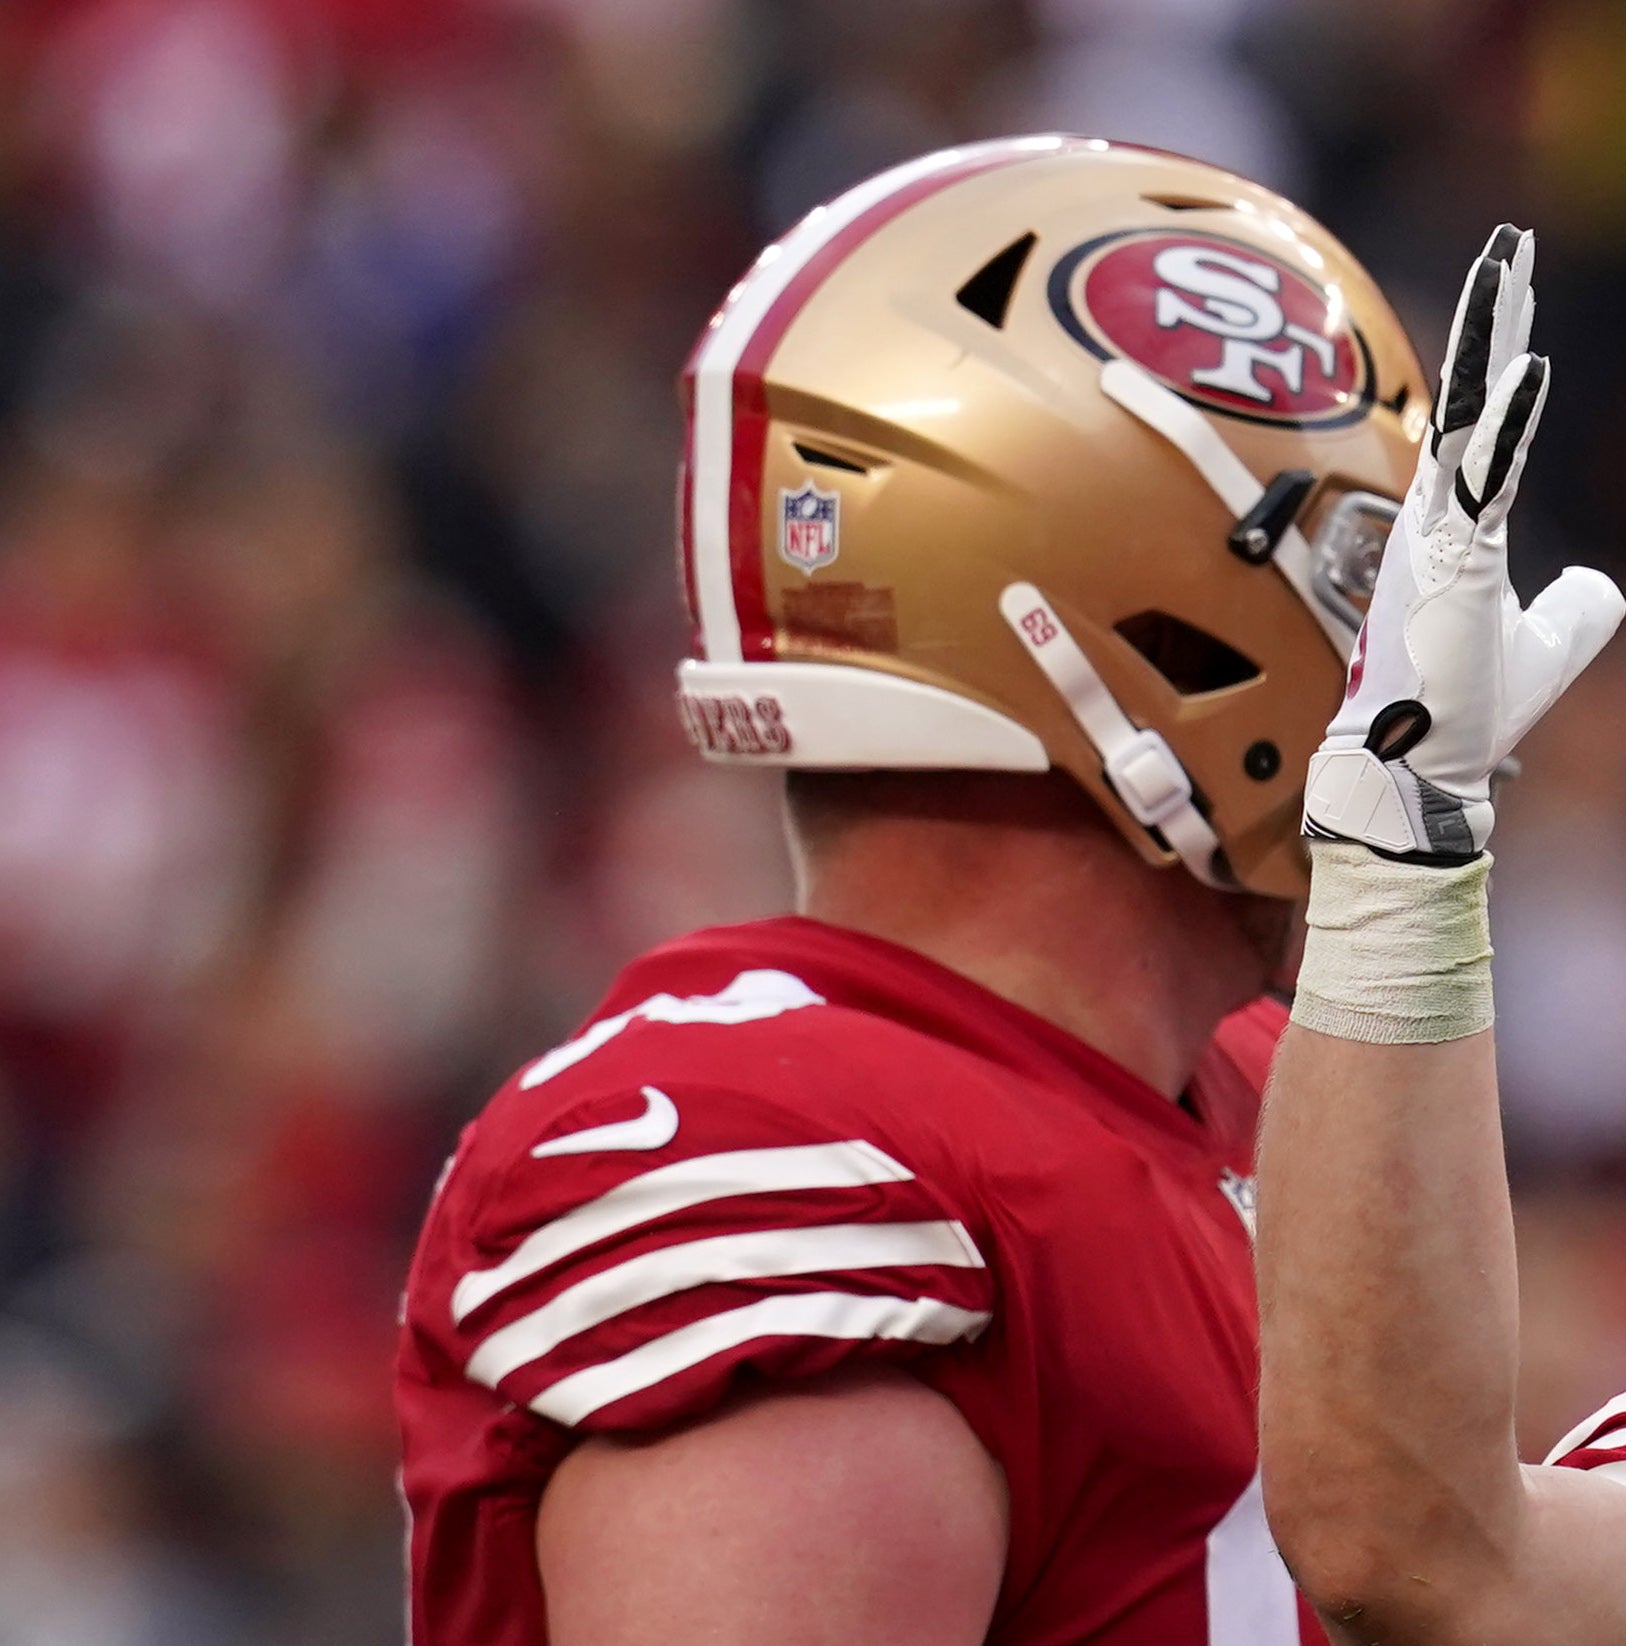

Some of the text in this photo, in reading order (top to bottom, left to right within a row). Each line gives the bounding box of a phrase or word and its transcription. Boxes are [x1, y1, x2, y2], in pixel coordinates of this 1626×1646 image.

[1154, 245, 1336, 401] SF
[788, 522, 829, 556] NFL
[1021, 607, 1058, 646] 69
